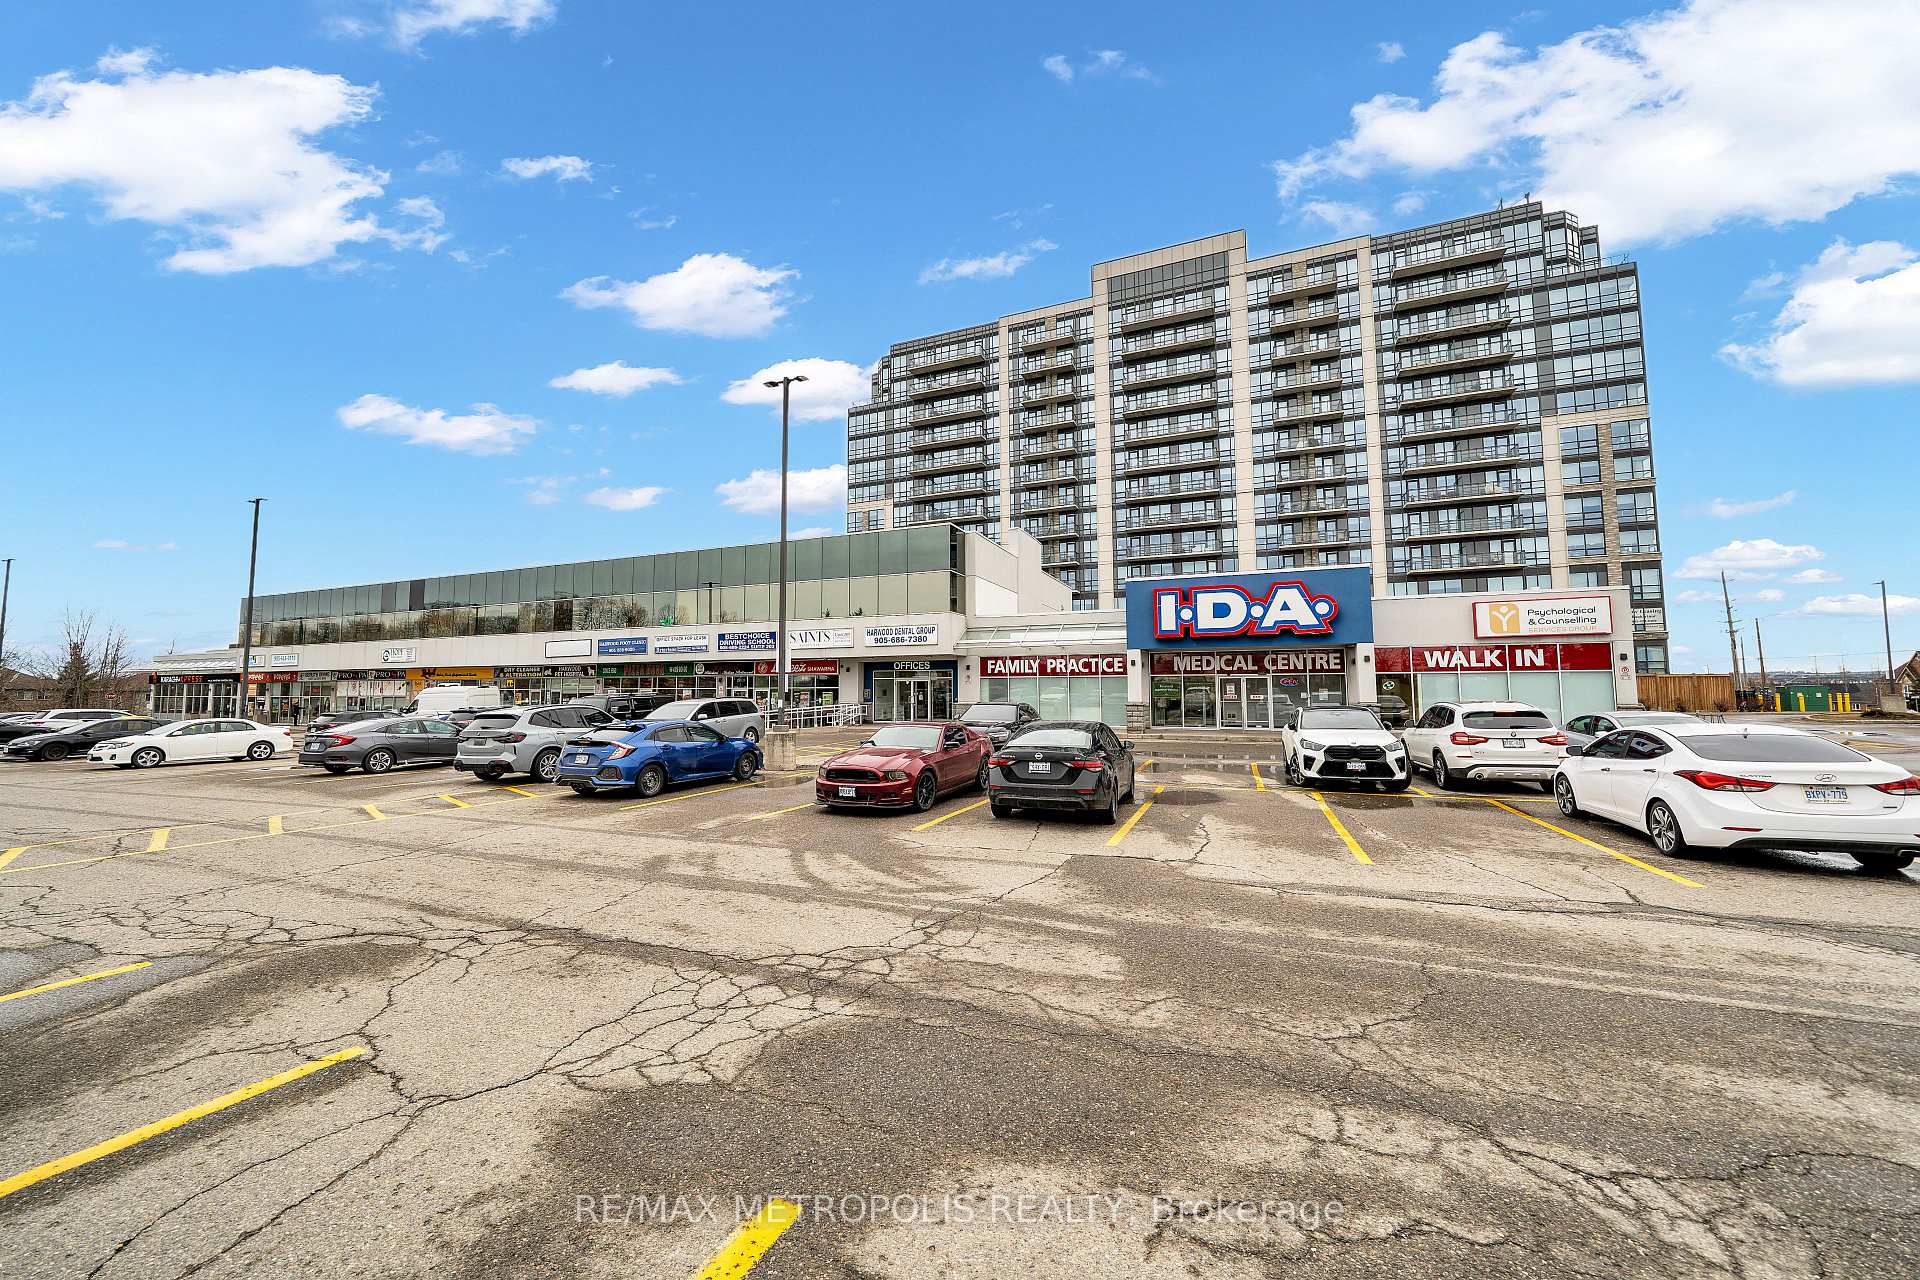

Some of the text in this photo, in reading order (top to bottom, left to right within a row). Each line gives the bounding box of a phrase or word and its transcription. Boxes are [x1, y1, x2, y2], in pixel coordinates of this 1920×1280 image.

[1527, 606, 1596, 616] Psychological
[1538, 616, 1597, 626] Counselling
[866, 626, 936, 637] HARWOOD DENTAL GROUP
[1173, 652, 1341, 672] MEDICAL CENTRE
[1424, 649, 1544, 668] WALK IN
[894, 661, 930, 670] OFFICES
[987, 656, 1123, 674] FAMILY PRACTICE
